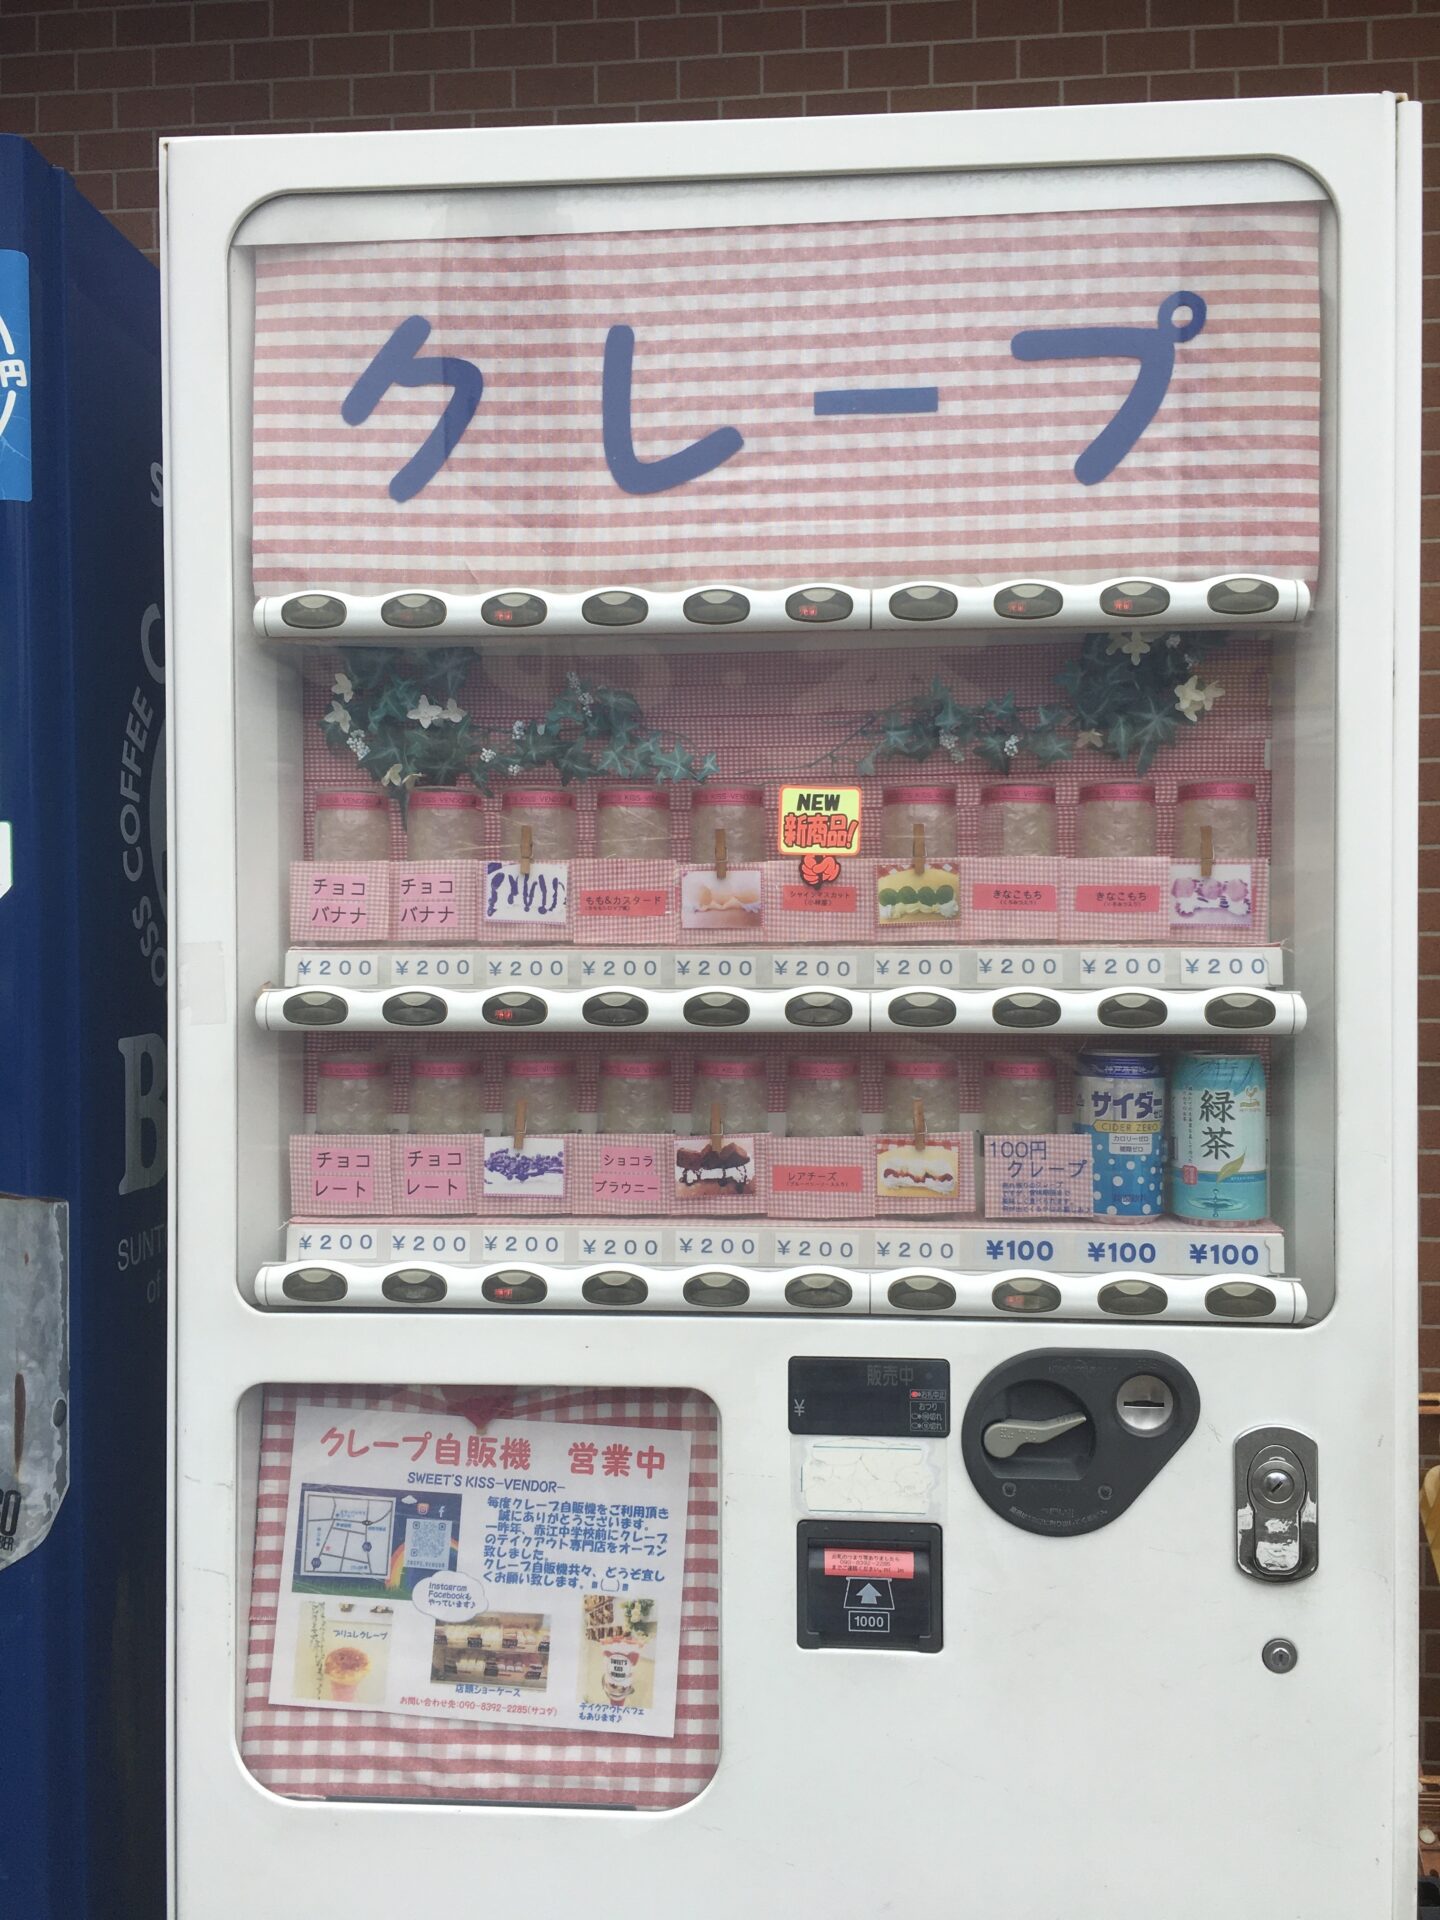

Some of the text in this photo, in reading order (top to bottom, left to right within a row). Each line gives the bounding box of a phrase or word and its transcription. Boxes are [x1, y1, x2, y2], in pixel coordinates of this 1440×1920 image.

[341, 290, 1207, 503] クレープ
[120, 686, 154, 881] COFFEE
[796, 793, 840, 811] NEW
[783, 813, 858, 848] 新商品!
[313, 878, 365, 896] チョコ
[401, 878, 453, 895] チョコ
[993, 889, 1042, 899] きなこもち
[586, 895, 660, 905] もも&カスタード
[1096, 891, 1147, 901] きなこもち
[312, 906, 366, 924] バナナ
[401, 905, 454, 924] バナナ
[298, 960, 371, 976] ¥200
[396, 959, 469, 975] ¥200
[489, 960, 563, 976] ¥200
[583, 960, 657, 976] ¥200
[677, 960, 752, 976] ¥200
[775, 960, 850, 976] ¥200
[876, 959, 953, 975] ¥200
[979, 958, 1056, 974] ¥200
[1083, 957, 1161, 974] ¥200
[1185, 957, 1265, 974] ¥200
[1091, 1091, 1162, 1119] サイダー
[1102, 1122, 1159, 1131] CIDER ZERO
[1199, 1089, 1235, 1160] 緑茶
[408, 1150, 461, 1167] チョコ
[989, 1141, 1046, 1160] 100円
[317, 1151, 370, 1168] チョコ
[603, 1154, 653, 1168] ショコラ
[788, 1171, 837, 1181] レアチーズ
[1008, 1159, 1087, 1178] クレープ
[315, 1180, 366, 1198] レート
[407, 1179, 457, 1196] レート
[595, 1179, 658, 1194] ブラウニー
[299, 1235, 372, 1250] ¥200
[392, 1235, 465, 1251] ¥200
[485, 1235, 559, 1252] ¥200
[583, 1239, 658, 1255] ¥200
[680, 1238, 755, 1254] ¥200
[777, 1240, 853, 1257] ¥200
[876, 1241, 954, 1259] ¥200
[986, 1240, 1054, 1262] ¥100
[1088, 1241, 1156, 1264] ¥100
[1190, 1243, 1258, 1266] ¥100
[867, 1365, 914, 1386] 販売中
[919, 1403, 938, 1411] おつり
[320, 1427, 666, 1480] クレープ自販機 営業中
[407, 1471, 463, 1487] SWEET'S
[498, 1509, 650, 1531] 誠にありがとうございます。
[483, 1545, 549, 1561] 致しました。
[485, 1534, 667, 1556] のテイクアウト専門店をオープン
[428, 1582, 467, 1592] Instagram
[428, 1590, 472, 1600] Facebookも
[854, 1616, 884, 1628] 1000
[455, 1683, 521, 1697] 店頭ショーケース
